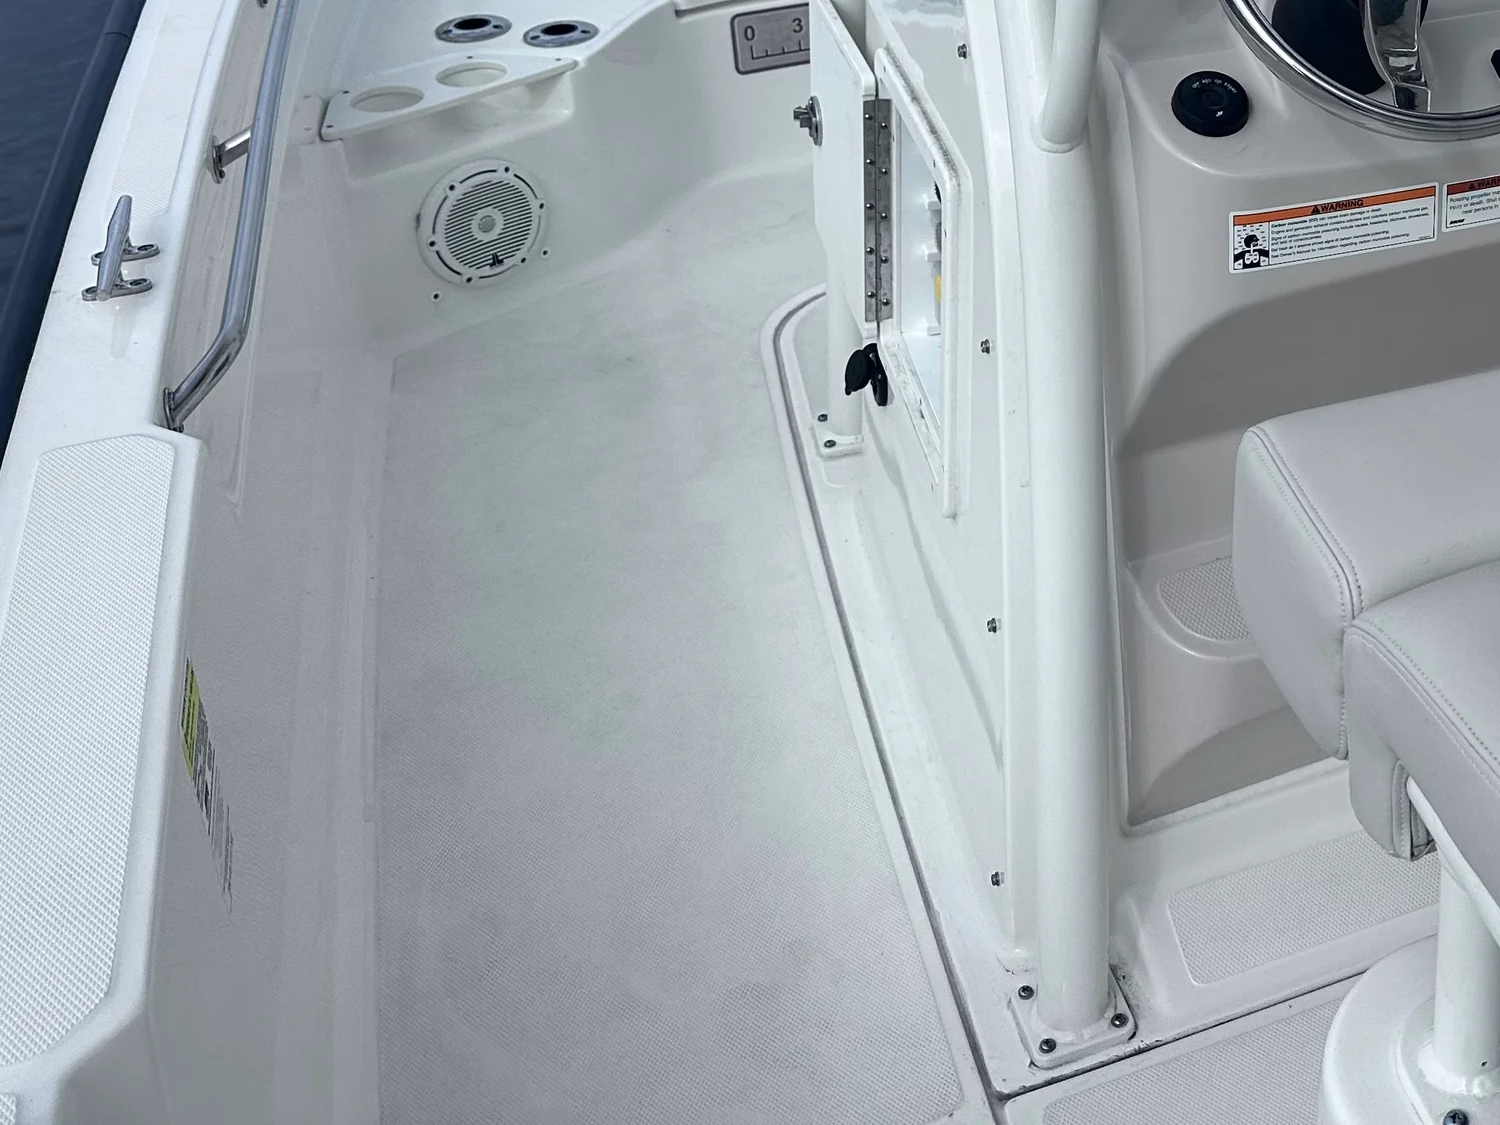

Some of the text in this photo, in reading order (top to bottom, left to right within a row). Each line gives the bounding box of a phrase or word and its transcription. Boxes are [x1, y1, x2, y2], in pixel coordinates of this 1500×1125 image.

[744, 18, 803, 41] 0 3
[1321, 199, 1364, 212] WARNING
